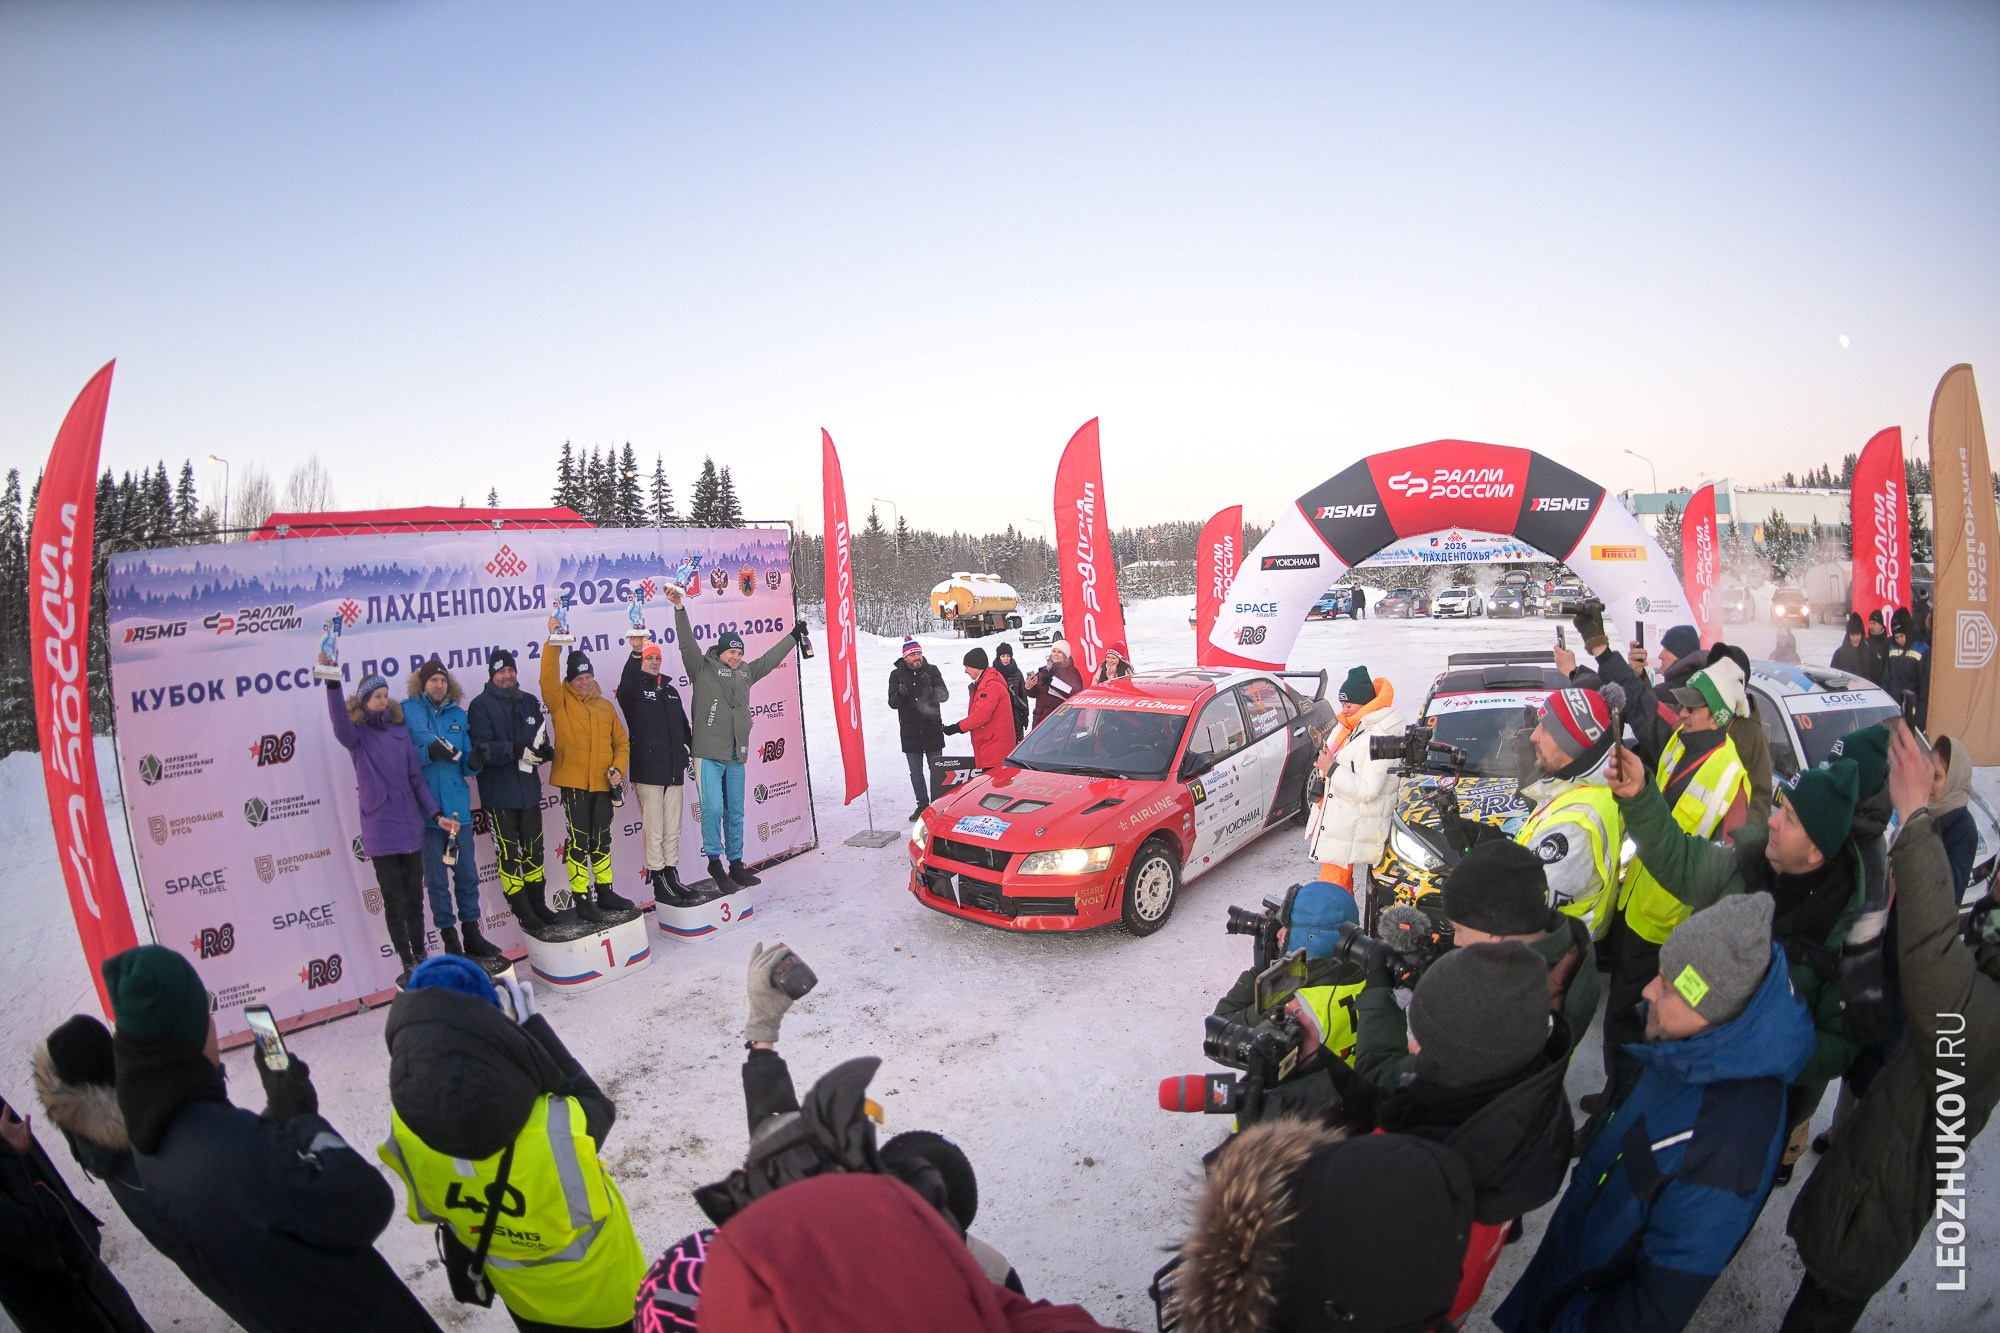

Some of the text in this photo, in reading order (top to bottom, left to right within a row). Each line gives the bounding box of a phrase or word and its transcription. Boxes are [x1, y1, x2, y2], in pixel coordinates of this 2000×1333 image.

[1433, 468, 1503, 483] РАЛЛИ
[1429, 484, 1514, 499] РОССИИ
[1322, 504, 1377, 519] ASMG
[1537, 498, 1590, 512] ASMG
[1959, 447, 1979, 601] КОРПОРАЦИЯ
[1444, 542, 1467, 550] 2026
[1873, 492, 1888, 598] РАЛЛИ
[1885, 480, 1901, 605] РОССИИ
[1422, 551, 1490, 562] ЛАХДЕНПОХЬЯ
[1601, 548, 1637, 559] PIRELLI
[1274, 557, 1317, 567] YOKOHAMA
[1213, 543, 1224, 600] РАЛЛИ
[1977, 541, 1988, 602] РУСЬ
[366, 577, 633, 625] ЛАХДЕНПОХЬЯ 2026
[1235, 602, 1278, 613] SPACE
[238, 604, 295, 622] РАЛЛИ
[131, 621, 188, 643] ASMG
[235, 617, 303, 636] РОССИИ
[1238, 626, 1267, 645] R8
[131, 678, 226, 713] КУБОК
[362, 657, 400, 678] ПО
[526, 641, 540, 659] 2
[1454, 698, 1516, 707] ТАТНЕФТЬ
[1821, 693, 1866, 704] LOGIC
[750, 701, 785, 718] SPACE
[766, 711, 785, 720] TRAVEL
[1056, 704, 1072, 717] 12
[1427, 715, 1438, 729] 9
[1794, 714, 1813, 730] 10
[257, 730, 296, 767] R8
[763, 738, 786, 763] R8
[164, 752, 198, 764] НЕРУДНЫЕ
[164, 758, 214, 772] СТРОИТЕЛЬНЫЕ
[164, 767, 203, 780] МАТЕРИАЛЫ
[951, 768, 982, 785] AS
[1016, 785, 1073, 799] VOLT
[1192, 784, 1205, 800] 12
[270, 794, 305, 806] НЕРУДНЫЕ
[270, 799, 321, 814] СТРОИТЕЛЬНЫЕ
[270, 809, 310, 821] МАТЕРИАЛЫ
[1129, 795, 1175, 826] AIRLINE
[169, 811, 224, 828] КОРПОРАЦИЯ
[771, 815, 802, 830] КОРПОРАЦИЯ
[1225, 807, 1260, 836] YOKOHAMA
[170, 827, 193, 837] РУСЬ
[771, 828, 784, 836] РУСЬ
[276, 848, 332, 867] КОРПОРАЦИЯ
[278, 865, 300, 875] РУСЬ
[480, 862, 499, 872] НЕРУД
[165, 869, 226, 895] SPACE
[197, 884, 228, 896] TRAVEL
[1081, 885, 1104, 898] START
[1081, 894, 1105, 907] VOLT
[272, 903, 334, 930] SPACE
[720, 902, 732, 922] 3
[305, 919, 336, 930] TRAVEL
[487, 920, 507, 931] РУСЬ
[200, 922, 235, 960] R8
[600, 938, 615, 968] 1
[308, 953, 342, 990] R8
[218, 983, 250, 996] НЕРУДНЫЕ
[218, 986, 266, 1003] СТРОИТЕЛЬНЫЕ
[220, 996, 257, 1010] МАТЕРИАЛЫ
[492, 1225, 541, 1242] SMG
